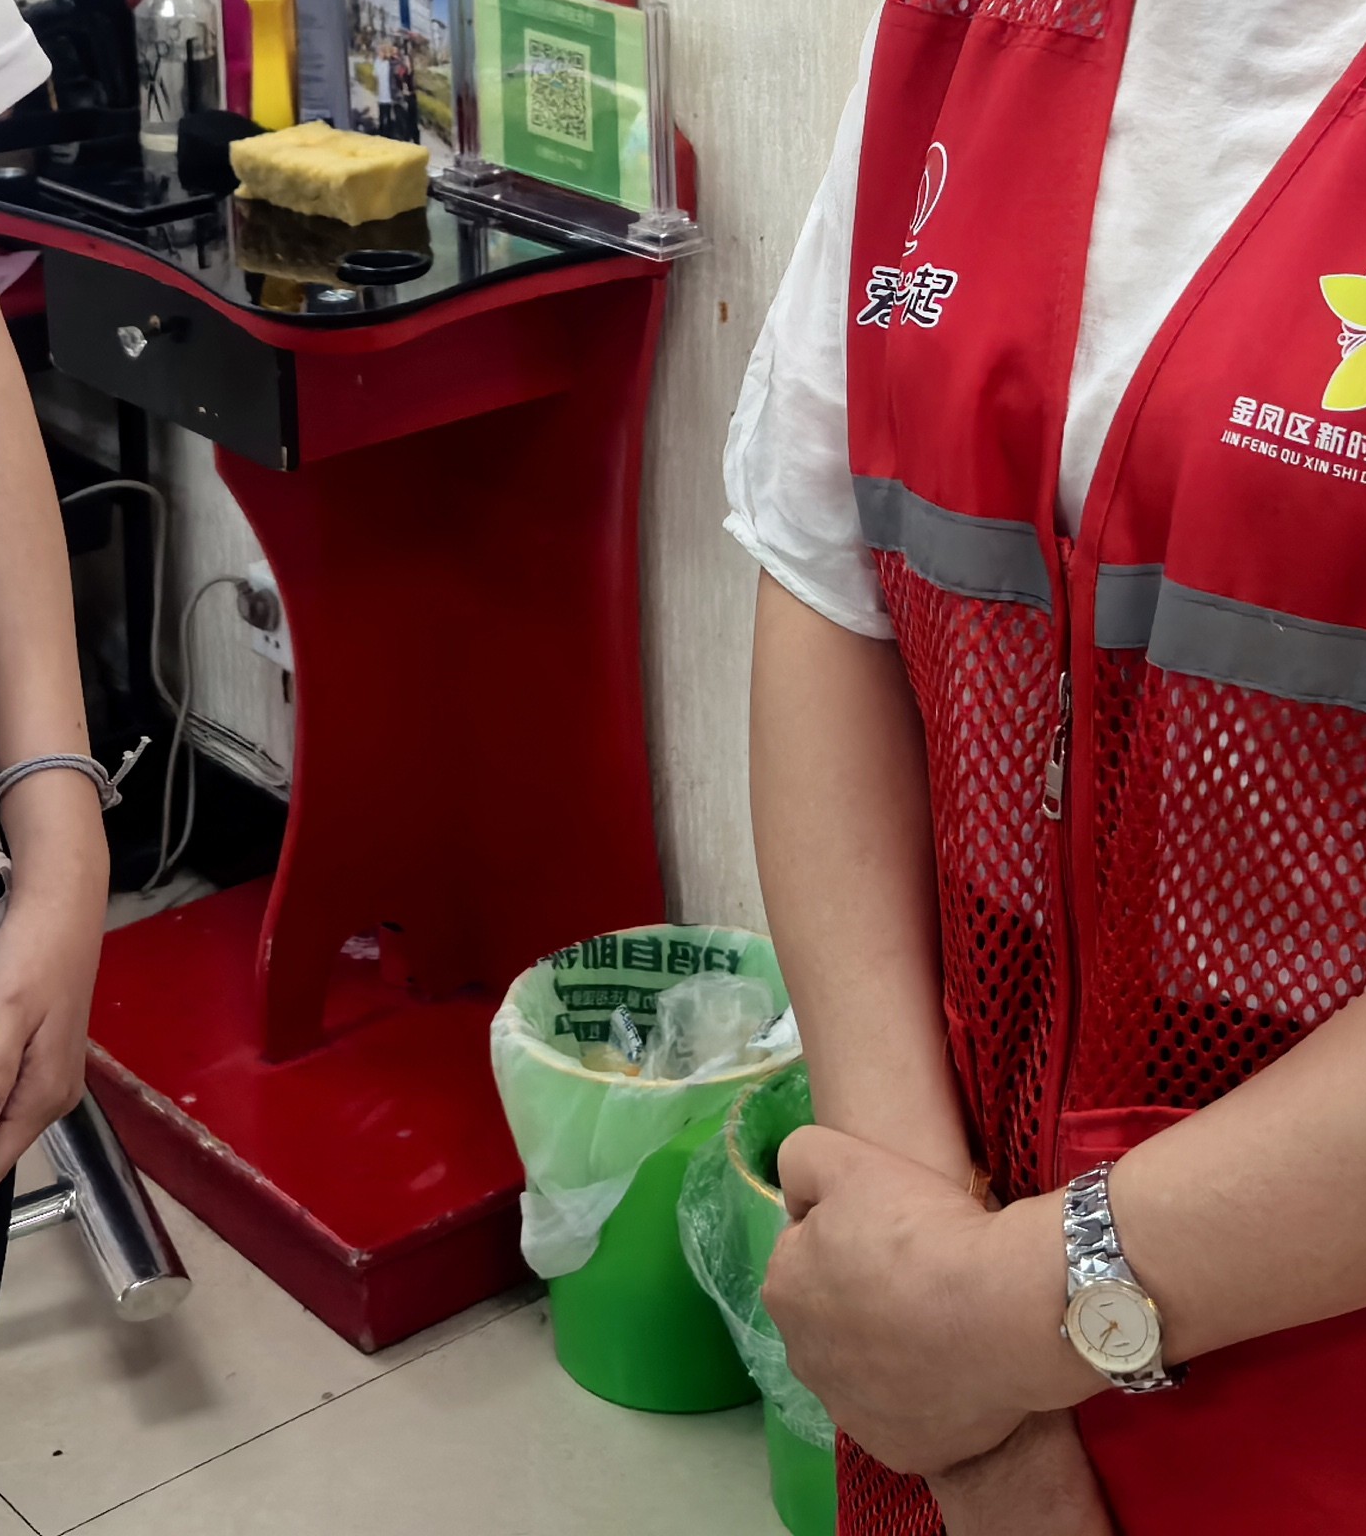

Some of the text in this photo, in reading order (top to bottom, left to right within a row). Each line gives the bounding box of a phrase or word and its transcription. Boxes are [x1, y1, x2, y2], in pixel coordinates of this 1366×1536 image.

[1220, 430, 1241, 447] JIN
[1241, 436, 1278, 458] FENG
[1280, 448, 1301, 465] QU
[1303, 455, 1330, 474] XIN
[1332, 463, 1358, 482] SHI
